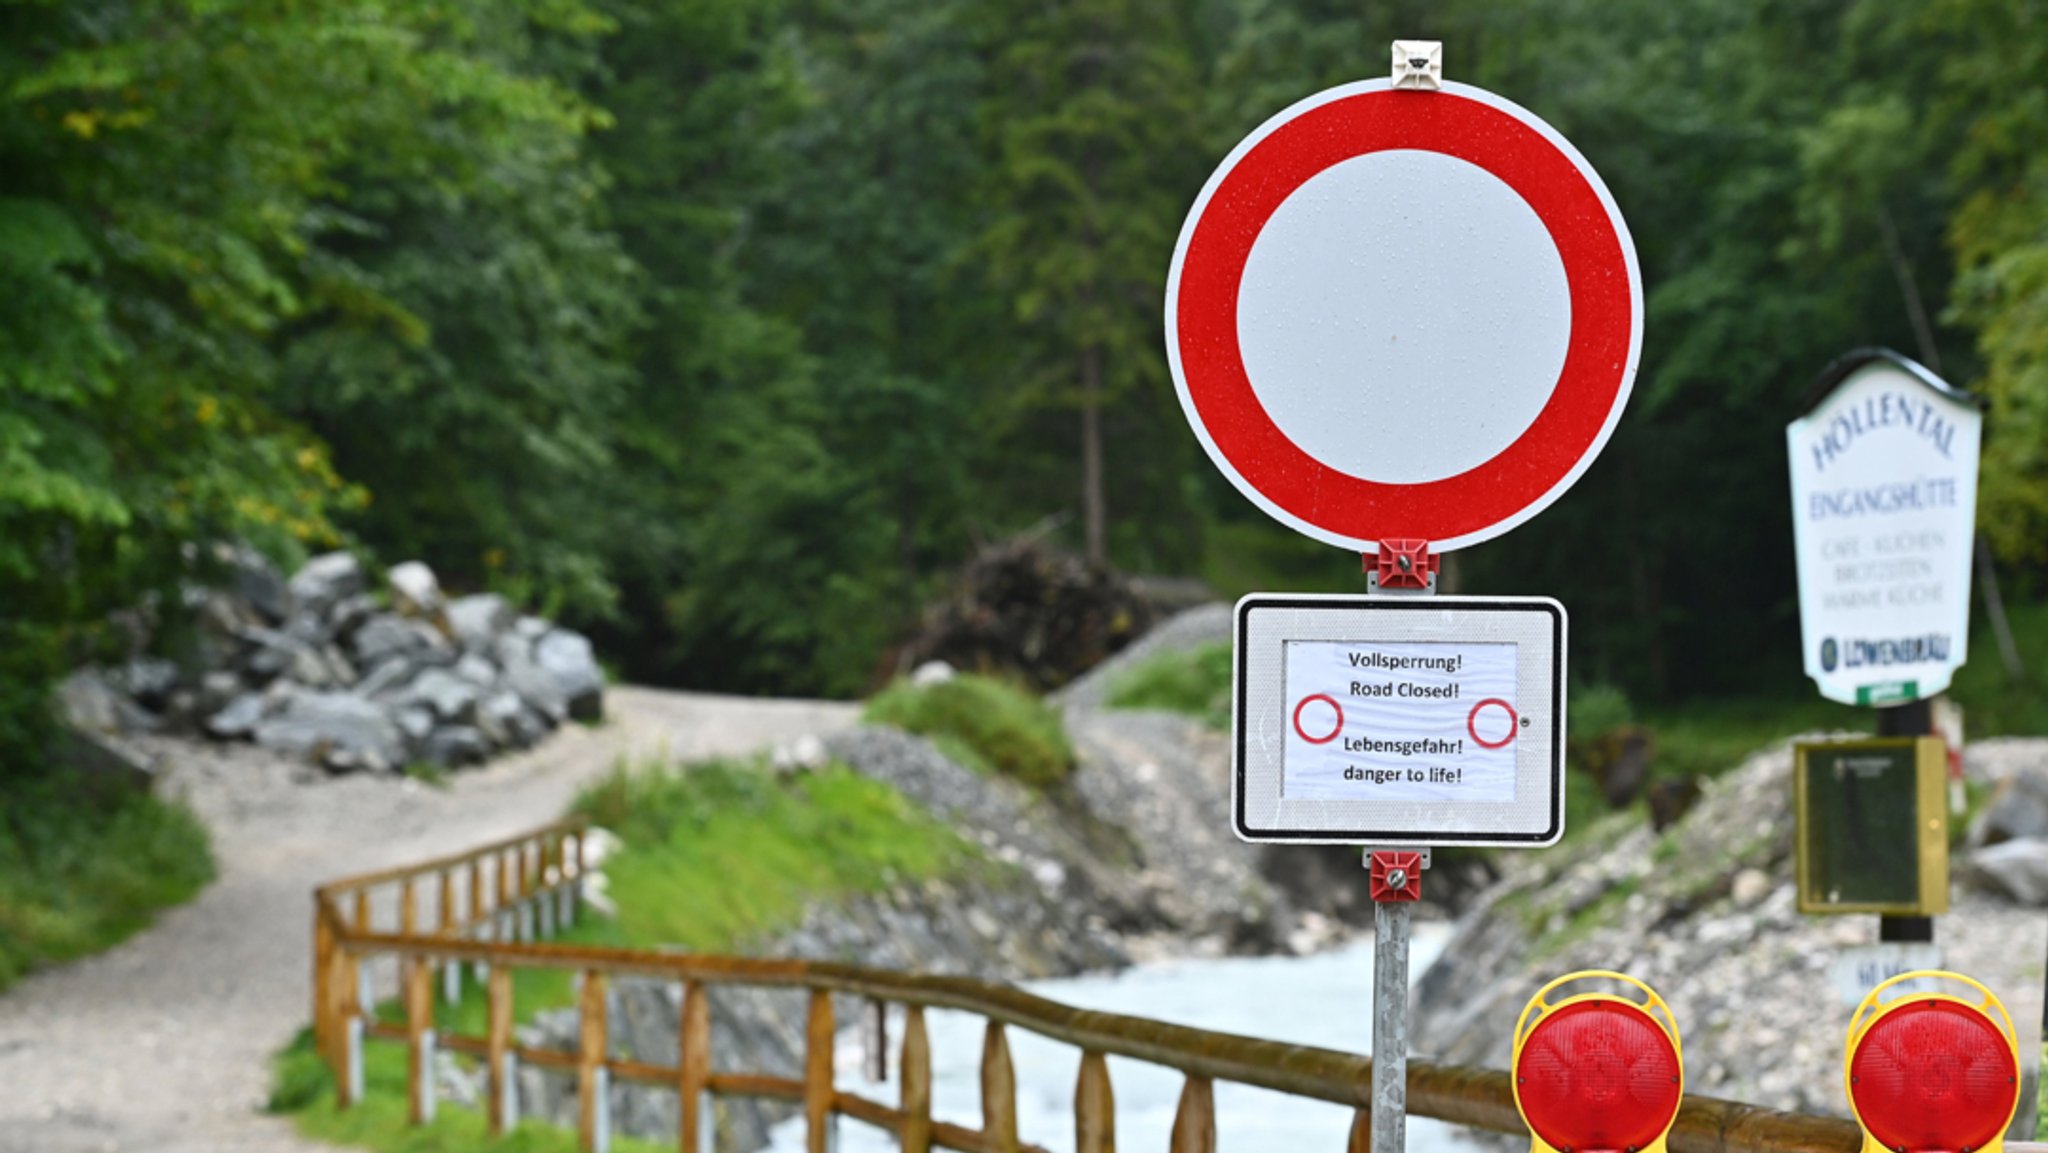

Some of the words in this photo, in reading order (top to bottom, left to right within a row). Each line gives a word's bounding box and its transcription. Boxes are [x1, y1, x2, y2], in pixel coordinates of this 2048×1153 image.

[1811, 391, 1955, 472] HÖLLENTAL
[1809, 475, 1956, 521] EINGANGSHÜTTE
[1348, 652, 1462, 673] Vollsperrung!
[1350, 681, 1393, 697] Road
[1397, 682, 1460, 698] Closed!
[1344, 737, 1463, 756] Lebensgefahr!
[1343, 765, 1402, 784] danger
[1407, 769, 1424, 782] to
[1429, 768, 1462, 783] life!
